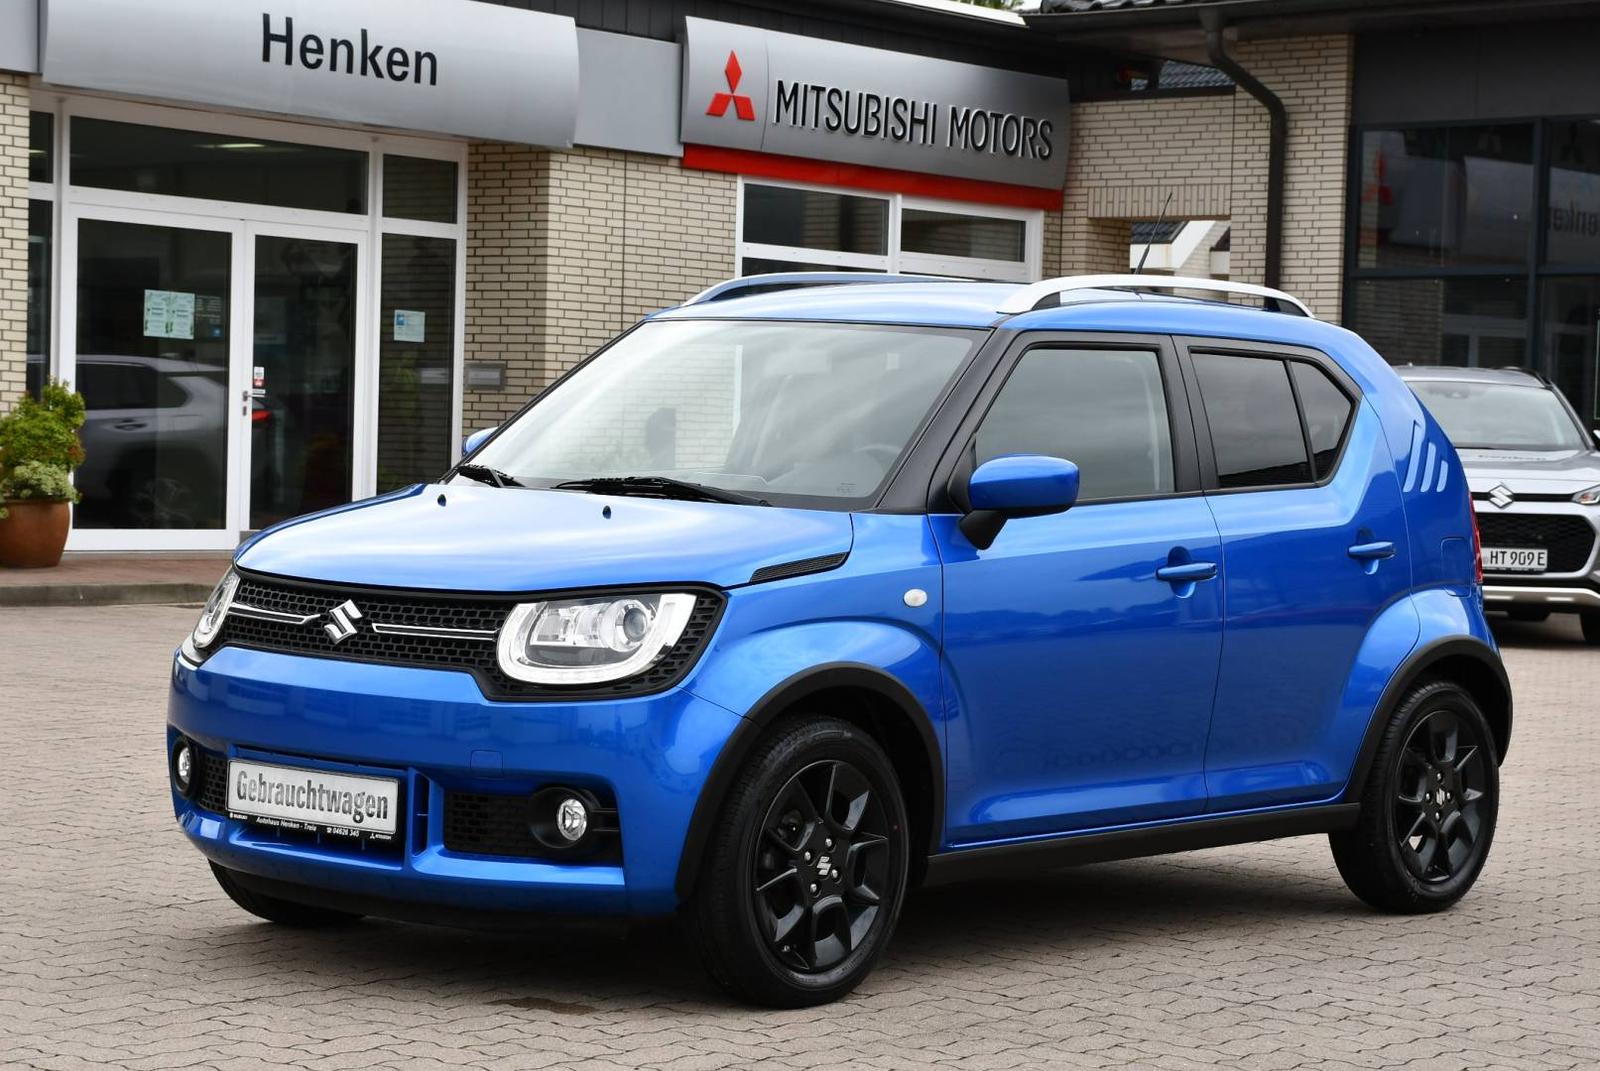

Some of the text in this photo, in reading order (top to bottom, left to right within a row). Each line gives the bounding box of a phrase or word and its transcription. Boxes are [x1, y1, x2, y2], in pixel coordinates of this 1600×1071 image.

[263, 13, 437, 86] Henken
[774, 80, 1053, 161] MITSUBISHI MOTORS
[236, 770, 388, 823] Gebrauchtwagen
